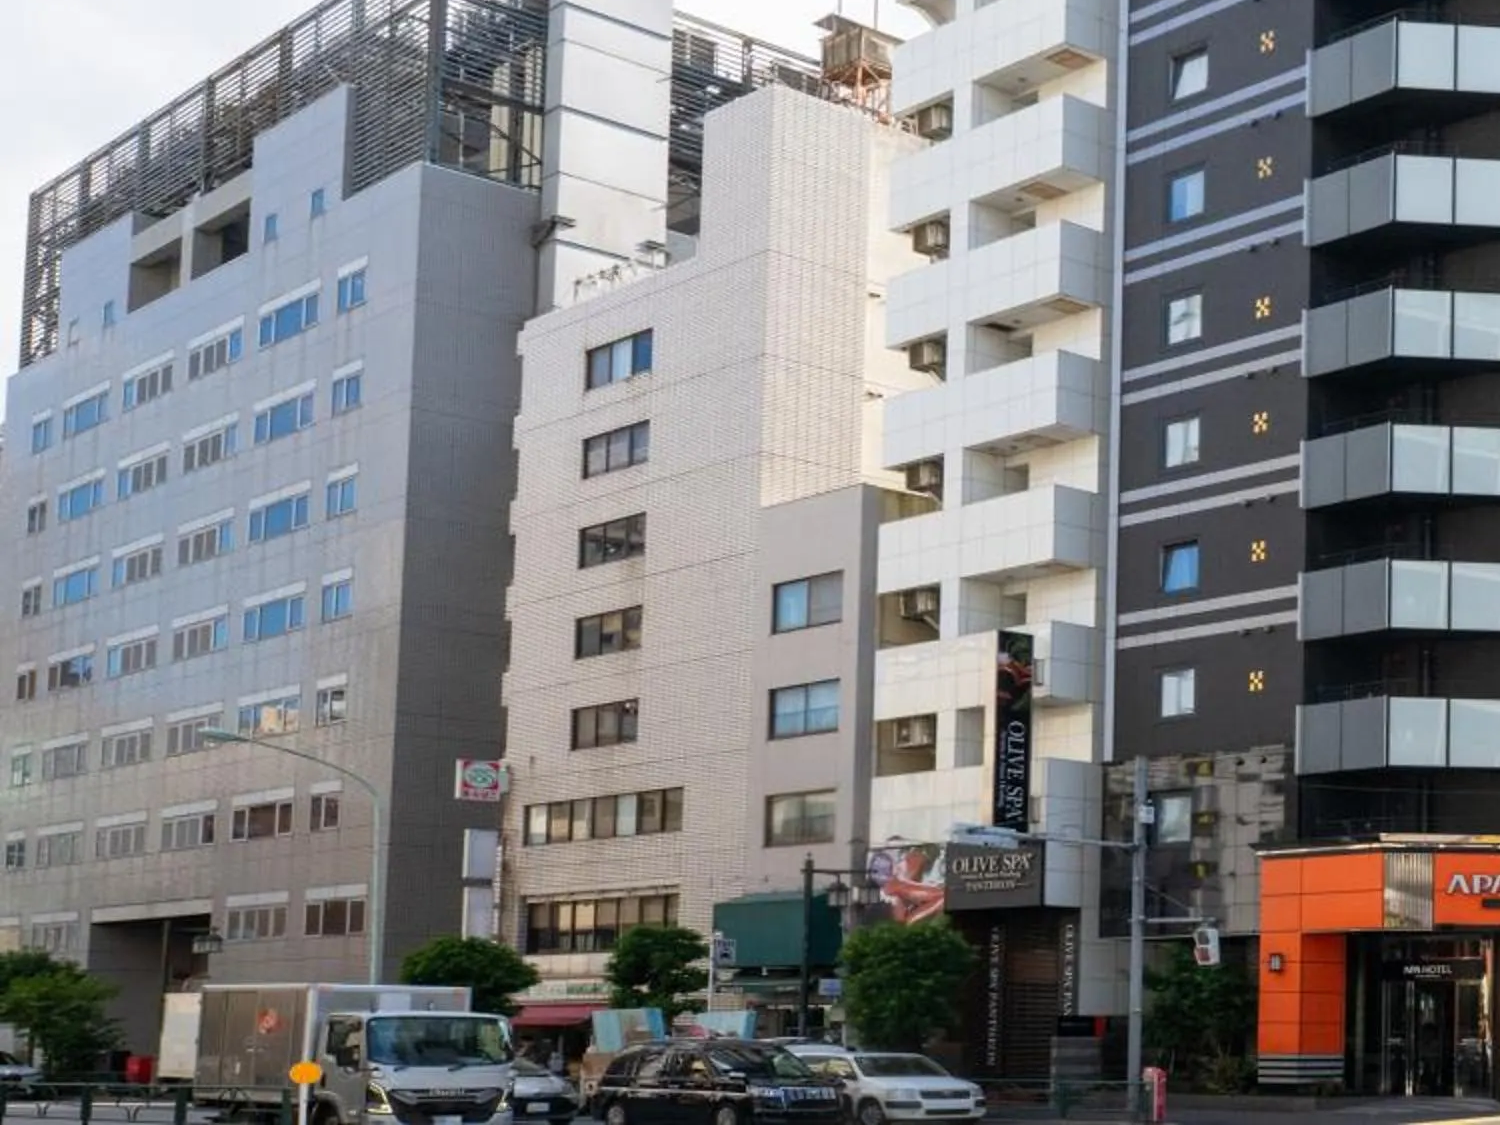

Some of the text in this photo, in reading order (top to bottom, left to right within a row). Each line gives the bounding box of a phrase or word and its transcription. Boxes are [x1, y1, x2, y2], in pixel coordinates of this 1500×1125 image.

[1005, 719, 1026, 820] OLIVE SPA
[951, 852, 1032, 875] OLIVE SPA
